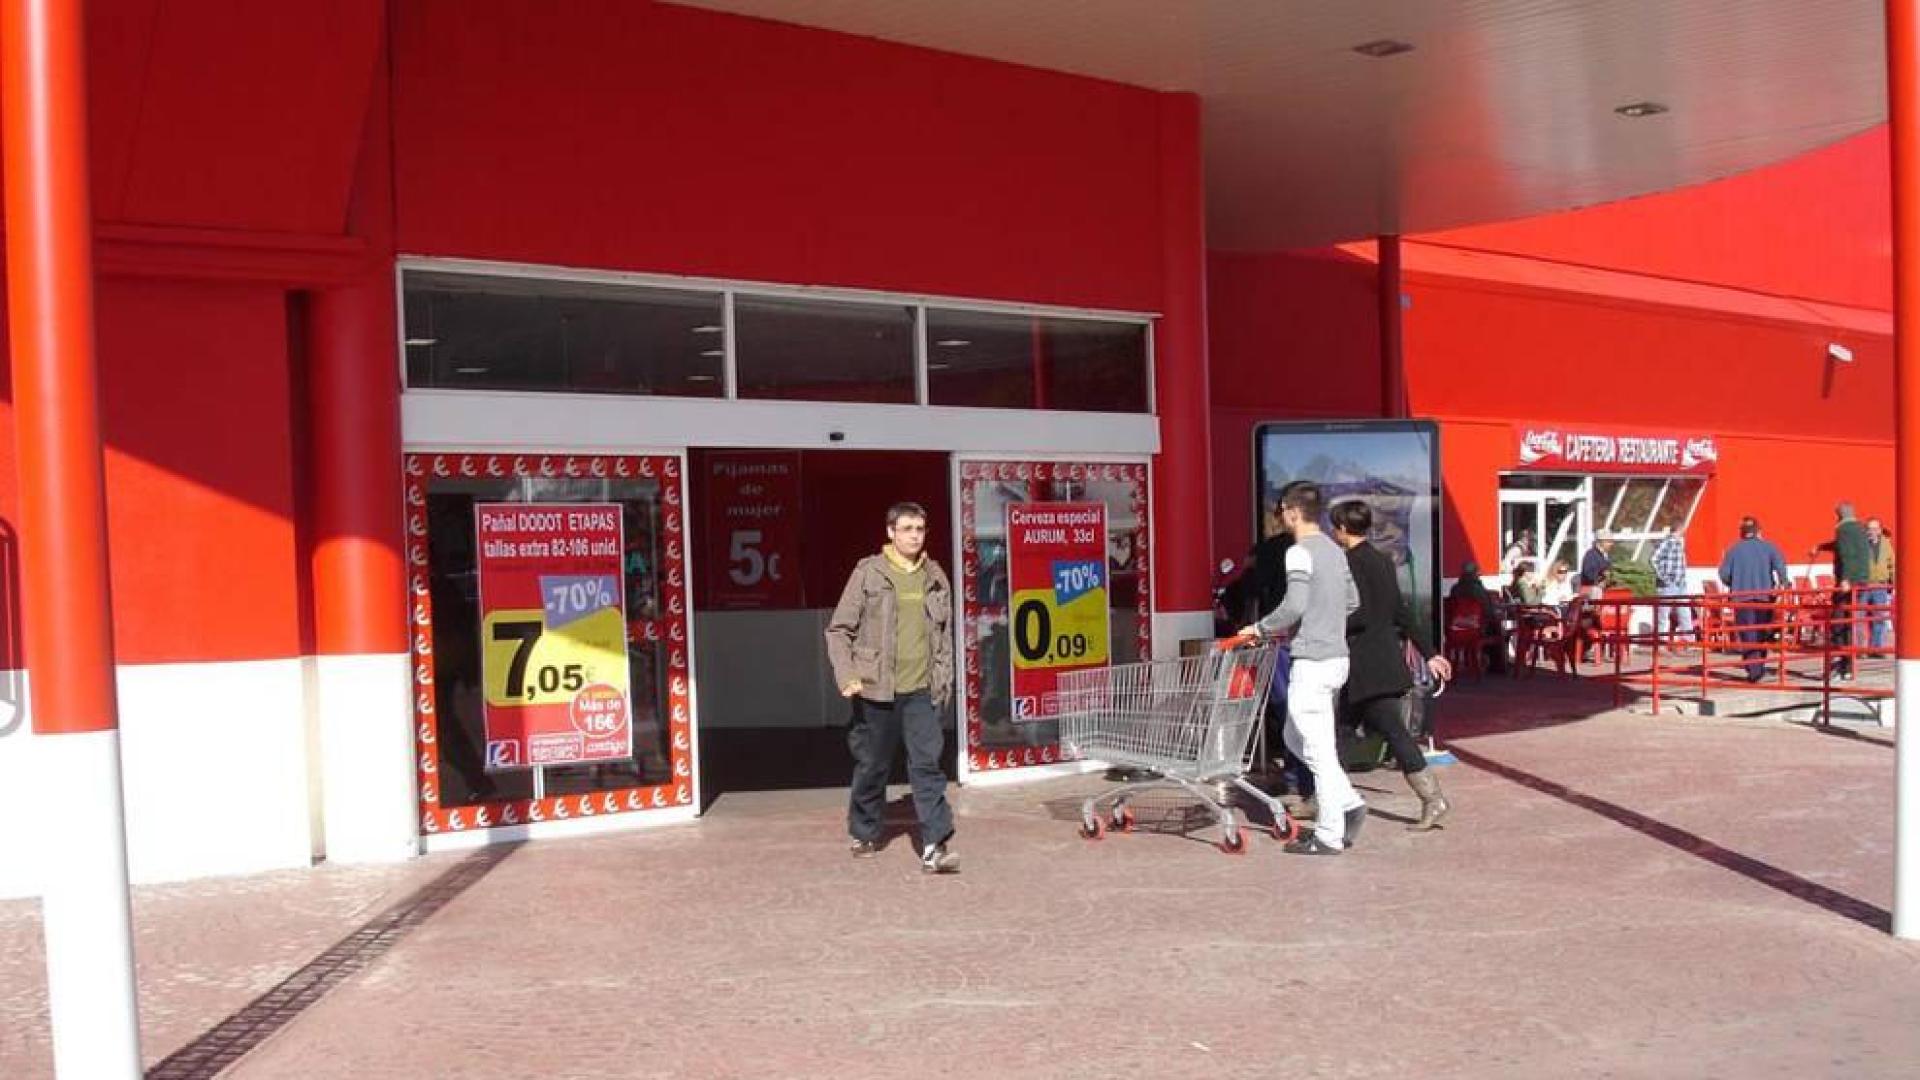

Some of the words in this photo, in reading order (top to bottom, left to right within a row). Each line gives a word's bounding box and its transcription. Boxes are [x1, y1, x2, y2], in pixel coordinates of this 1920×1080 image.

[1617, 437, 1679, 465] RESTAURANTE
[713, 463, 788, 477] Pijamas
[739, 484, 764, 495] de
[727, 502, 781, 518] mujer
[1012, 510, 1055, 525] Cerveza
[1057, 508, 1100, 527] especial
[519, 513, 562, 531] DODOT
[568, 512, 614, 531] ETAPAS
[484, 540, 516, 557] tallas
[518, 539, 549, 557] extra
[1056, 562, 1099, 592] -70%
[546, 578, 611, 614] -70%
